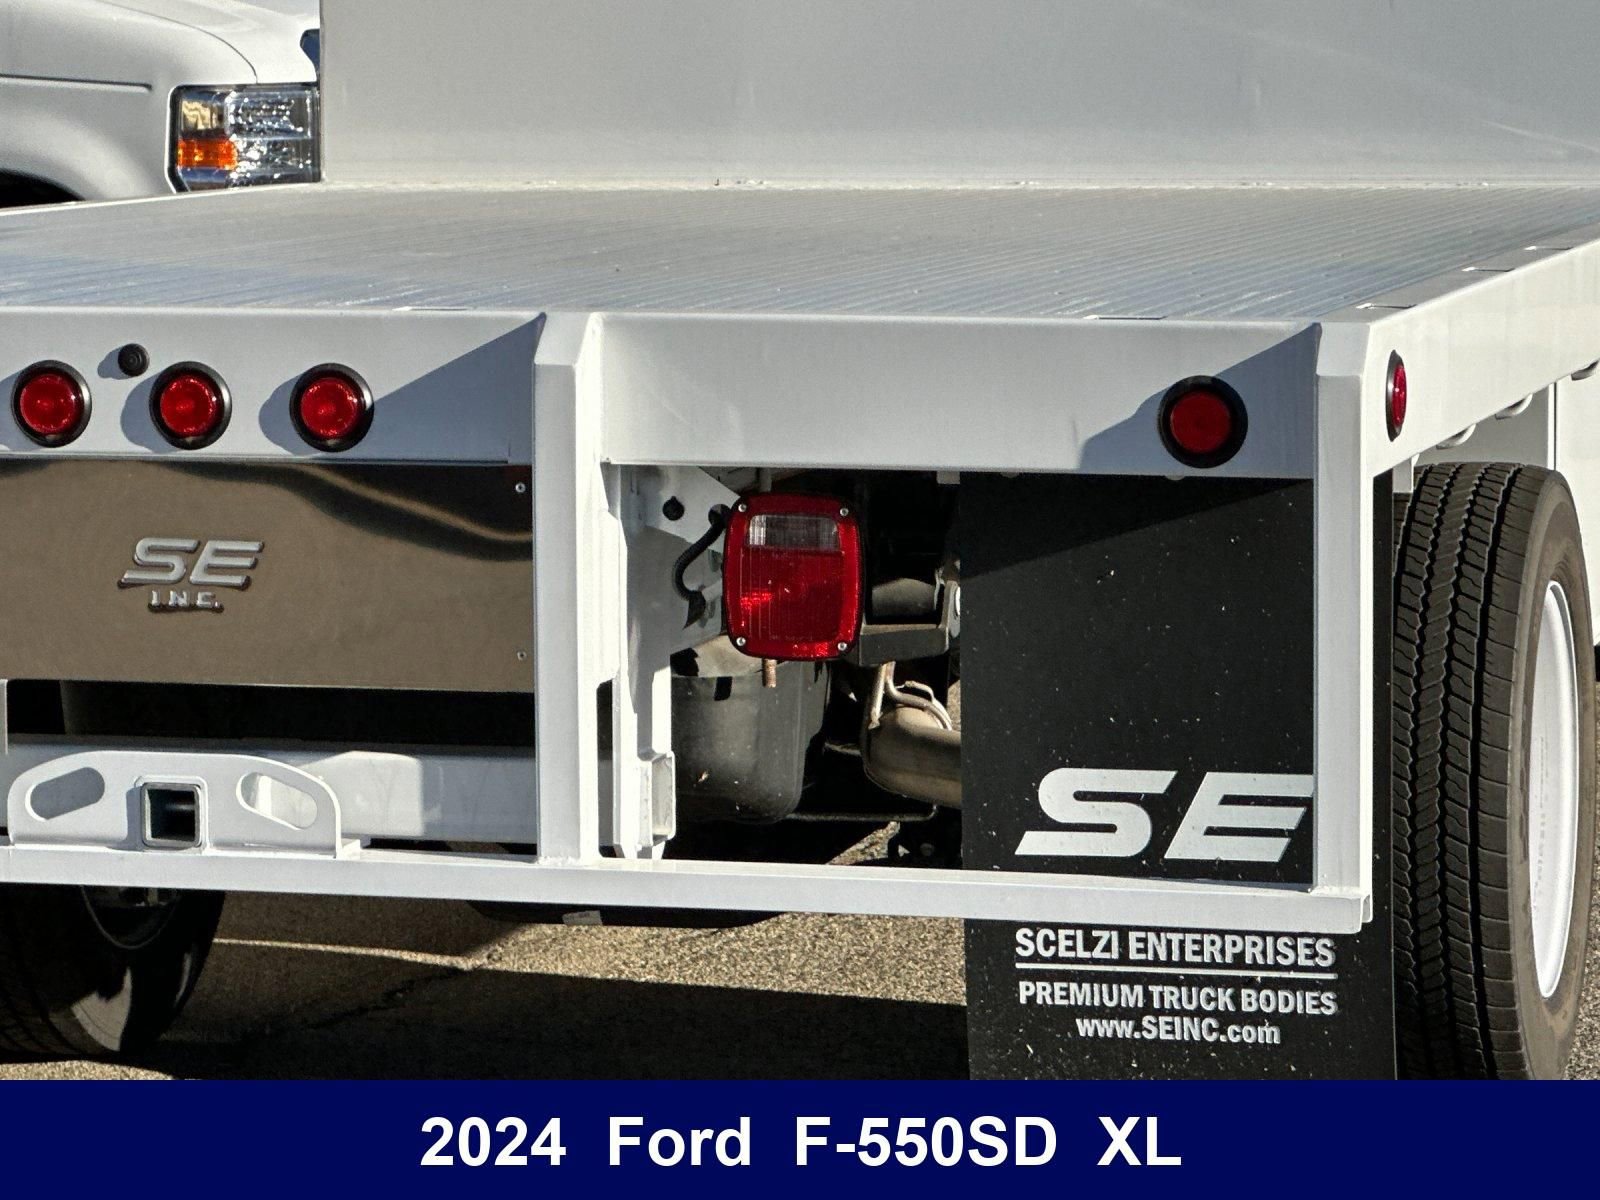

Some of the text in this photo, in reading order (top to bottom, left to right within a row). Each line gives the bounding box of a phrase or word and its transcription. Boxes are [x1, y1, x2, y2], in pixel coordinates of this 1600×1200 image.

[119, 537, 264, 588] SE
[1014, 767, 1314, 862] SE
[1015, 928, 1336, 967] SCELZI ENTERPRISES
[1018, 981, 1338, 1016] PREMIUM TRUCK BODIES
[1075, 1016, 1281, 1044] www.SEINC.com
